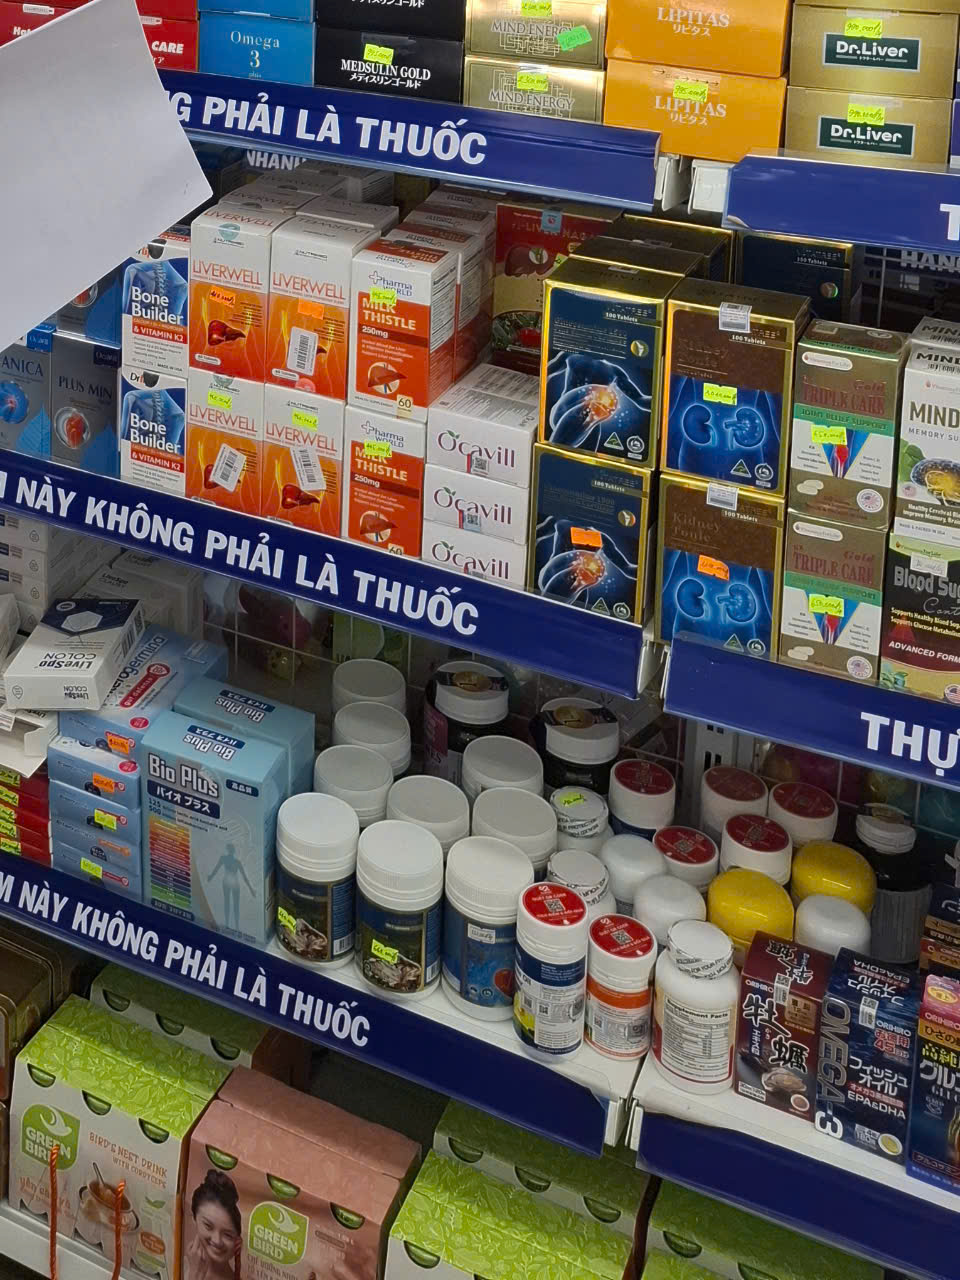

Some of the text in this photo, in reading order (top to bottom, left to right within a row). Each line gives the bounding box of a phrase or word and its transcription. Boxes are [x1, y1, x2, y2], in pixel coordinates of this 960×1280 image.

[151, 42, 184, 55] CARE
[835, 40, 909, 58] Dr.Liver
[341, 59, 431, 81] MEDSULIN GOLD
[202, 91, 285, 136] PHẢI
[296, 105, 340, 145] LÀ
[355, 117, 488, 165] THUỐC
[192, 259, 263, 286] LIVERWELL
[131, 286, 169, 307] Bone
[272, 272, 346, 300] LIVERWELL
[131, 302, 184, 326] Builder
[364, 310, 416, 330] THISTLE
[362, 325, 389, 339] 250mg
[1, 355, 44, 377] ANICA
[58, 375, 112, 400] PLUS MIN
[398, 397, 412, 409] 60
[130, 413, 167, 434] Bone
[189, 404, 258, 432] LIVERWELL
[130, 428, 181, 454] Builder
[908, 427, 940, 439] MEMORY
[354, 473, 380, 487] 250mg
[355, 459, 408, 481] THISTLE
[16, 476, 77, 518] NÀY
[85, 501, 194, 554] KHÔNG
[205, 531, 283, 579] PHẢI
[296, 552, 339, 595] LÀ
[353, 570, 479, 636] THUỐC
[148, 753, 219, 799] Bio Plus
[18, 881, 66, 924] NÀY
[71, 904, 158, 962] KHÔNG
[164, 943, 227, 988] PHẢI
[234, 965, 266, 1007] LÀ
[278, 984, 370, 1048] THUỐC
[876, 1019, 912, 1036] ORIHIRO
[815, 994, 851, 1139] OMEGA-3
[850, 1055, 908, 1088] フィッシュ
[858, 1071, 898, 1096] オイル
[847, 1091, 906, 1120] EPA&DHA
[26, 1126, 71, 1160] GREEN
[253, 1238, 283, 1261] BIRD
[254, 1225, 298, 1255] GREEN
